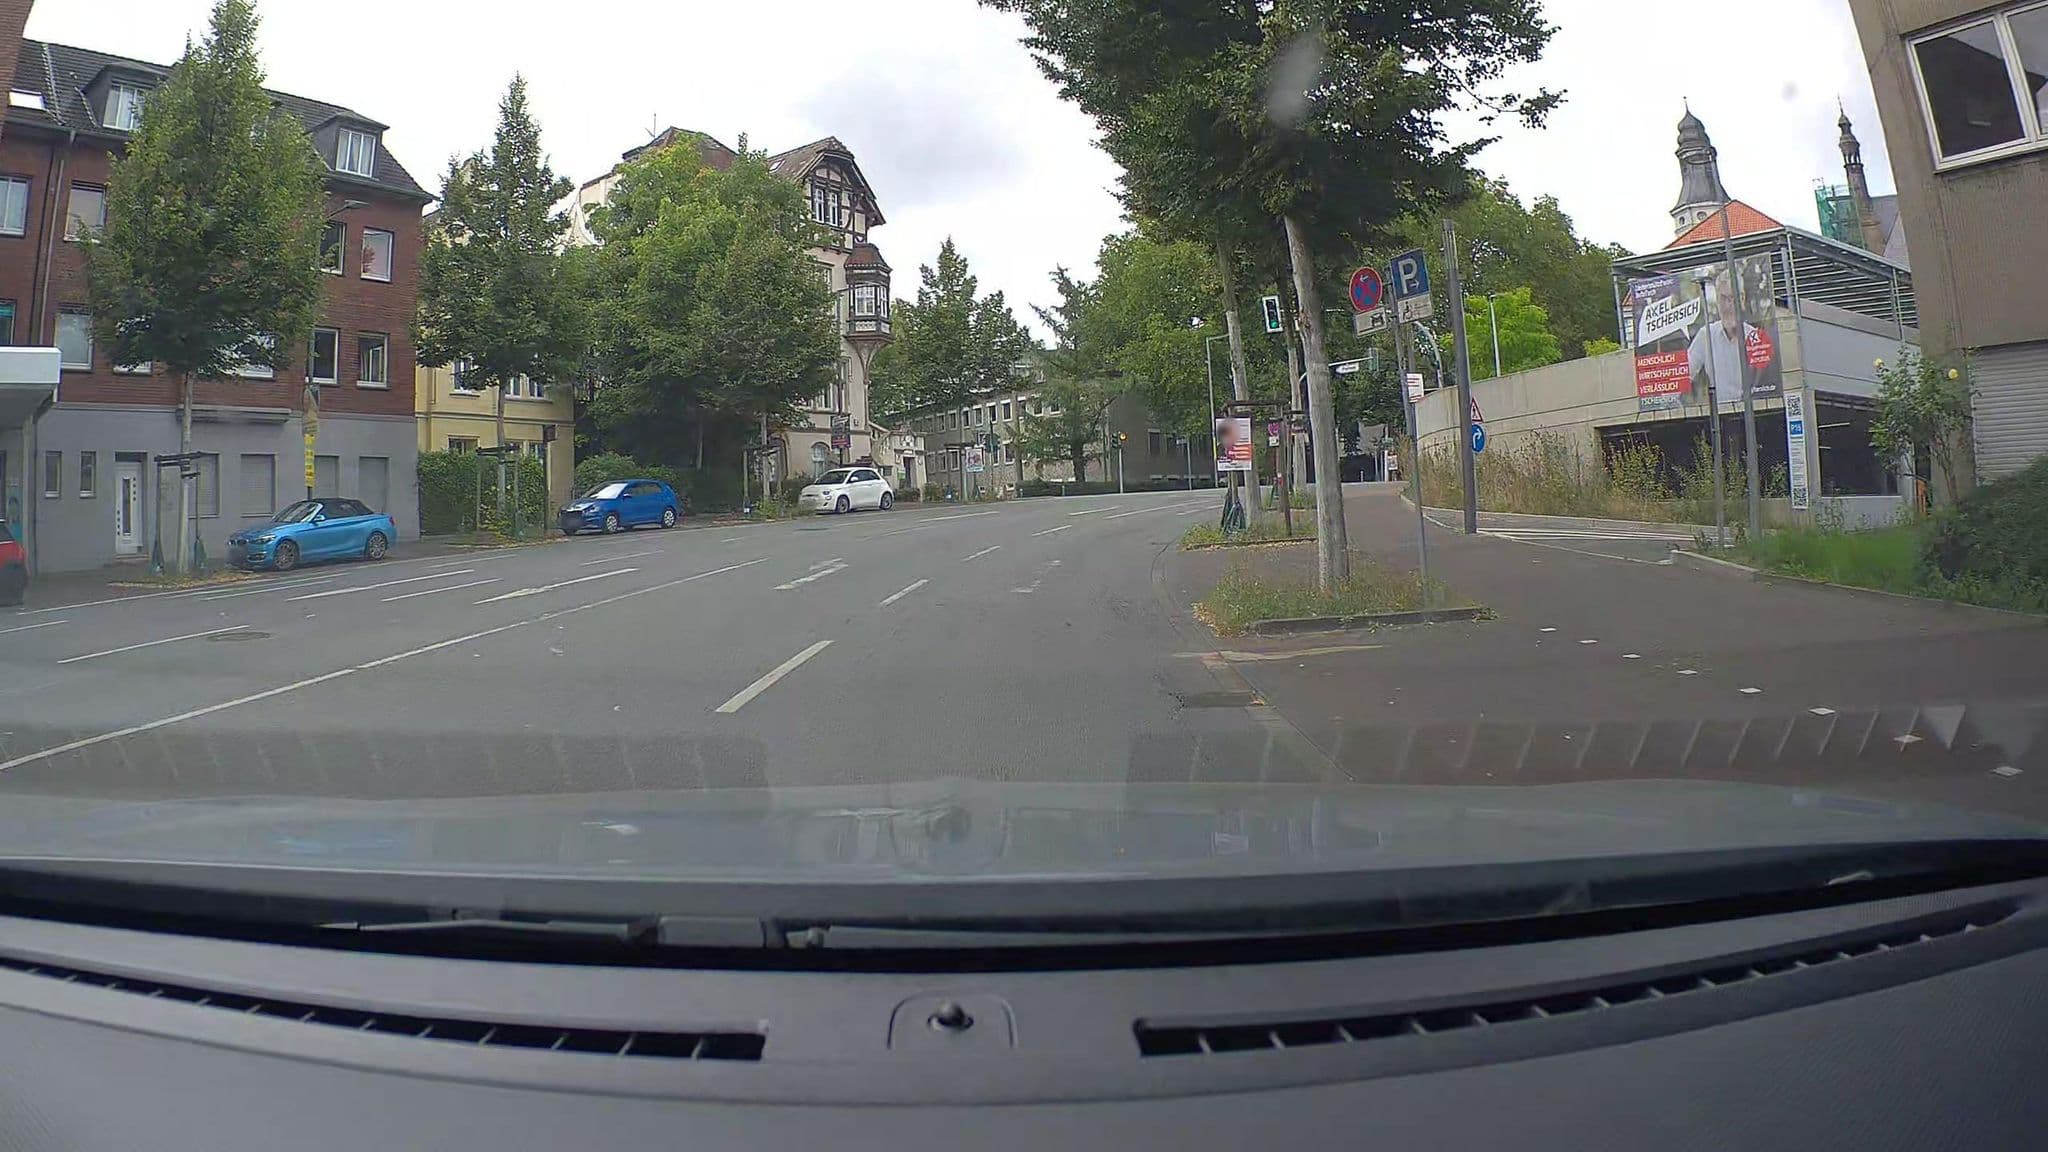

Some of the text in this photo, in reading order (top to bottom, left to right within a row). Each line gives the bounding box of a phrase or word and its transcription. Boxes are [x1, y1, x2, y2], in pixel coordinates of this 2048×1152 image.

[1398, 258, 1417, 294] P
[1645, 300, 1670, 320] AXEL
[1646, 301, 1699, 334] TSCHERSICH
[1637, 353, 1676, 366] MENSCHLICH
[1639, 366, 1689, 381] WIRTSCHAFTLICH
